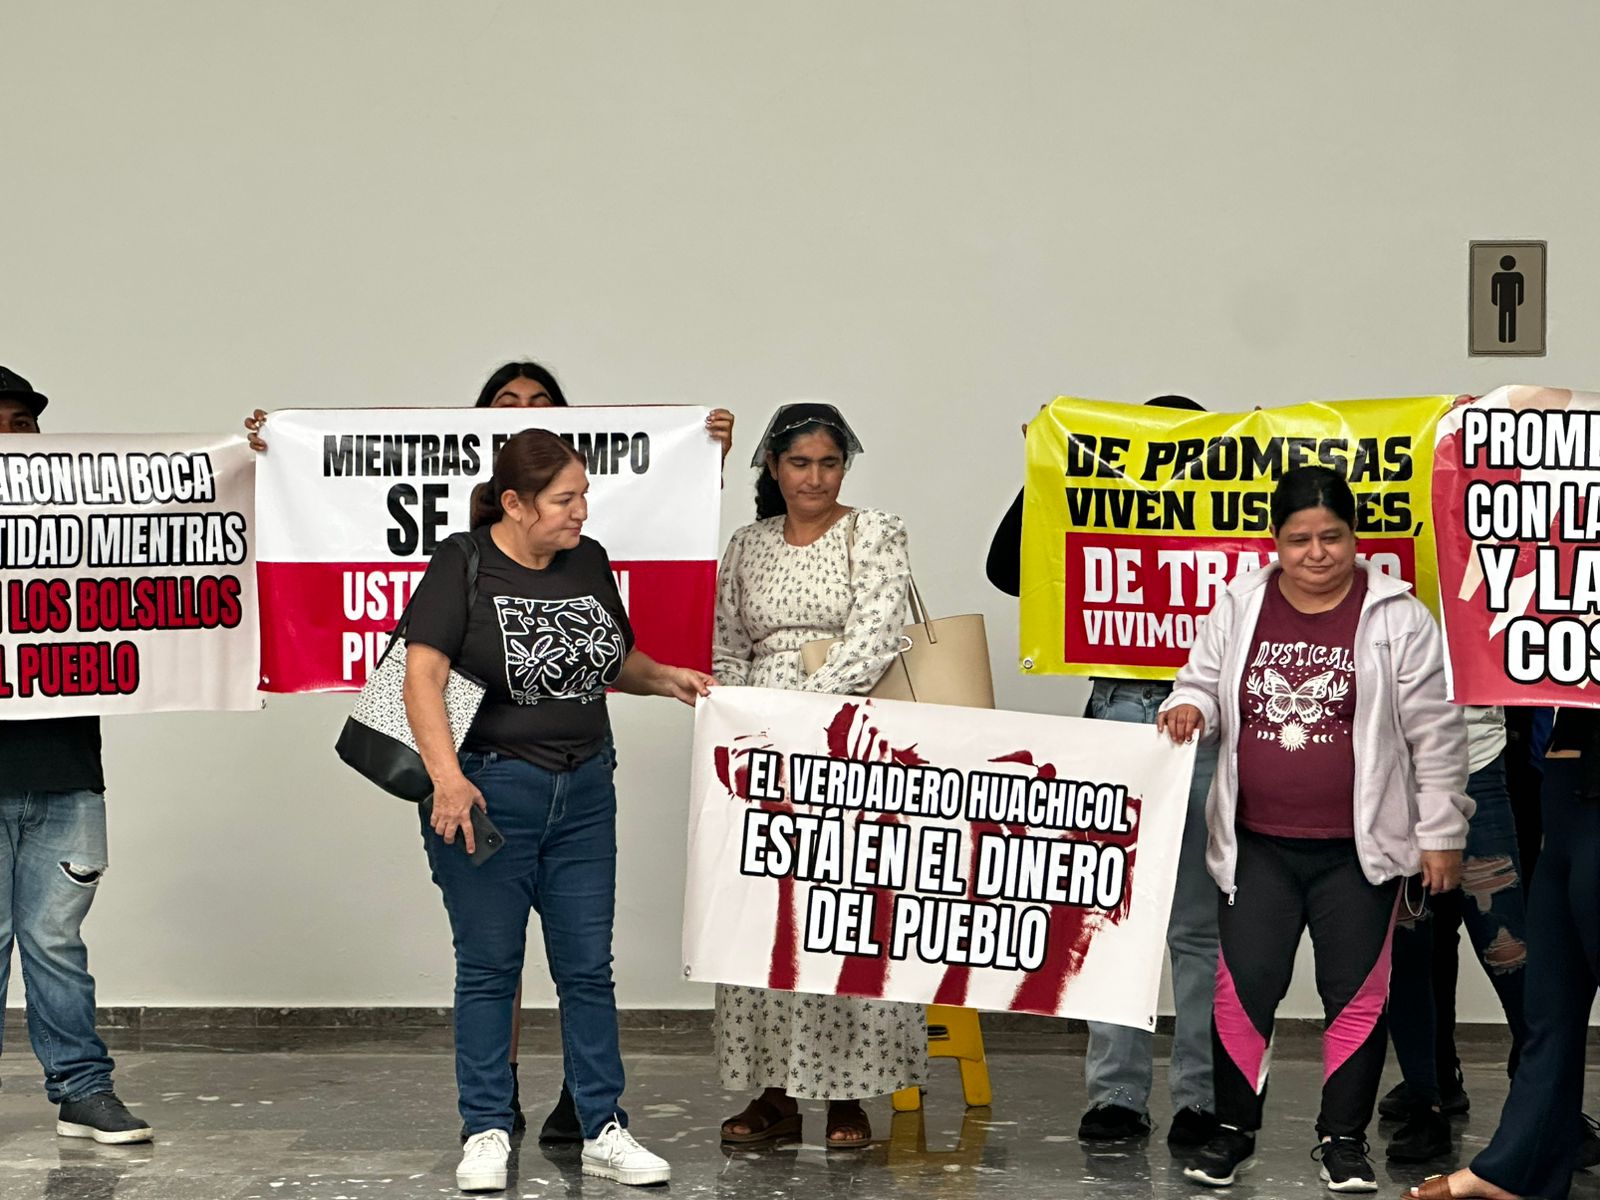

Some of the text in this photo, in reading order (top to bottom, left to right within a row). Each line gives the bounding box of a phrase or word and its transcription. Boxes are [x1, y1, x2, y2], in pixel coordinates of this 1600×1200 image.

[79, 454, 124, 503] LA
[127, 452, 215, 503] BOCA
[323, 433, 480, 477] MIENTRAS
[1066, 434, 1413, 482] DE PROMESAS
[88, 512, 247, 567] MIENTRAS
[387, 483, 449, 556] SE
[1066, 488, 1424, 537] VIVEN USES,
[1464, 480, 1551, 542] CON
[8, 578, 71, 633] LOS
[77, 575, 242, 632] BOLSILLOS
[1083, 546, 1144, 605] DE
[1477, 544, 1600, 615] Y LA
[18, 641, 140, 697] PUEBLO
[748, 749, 1130, 833] EL VERDADERO HUACHICOL
[741, 805, 1129, 912] ESTÁ EN EL DINERO
[804, 886, 1051, 972] DEL PUEBLO
